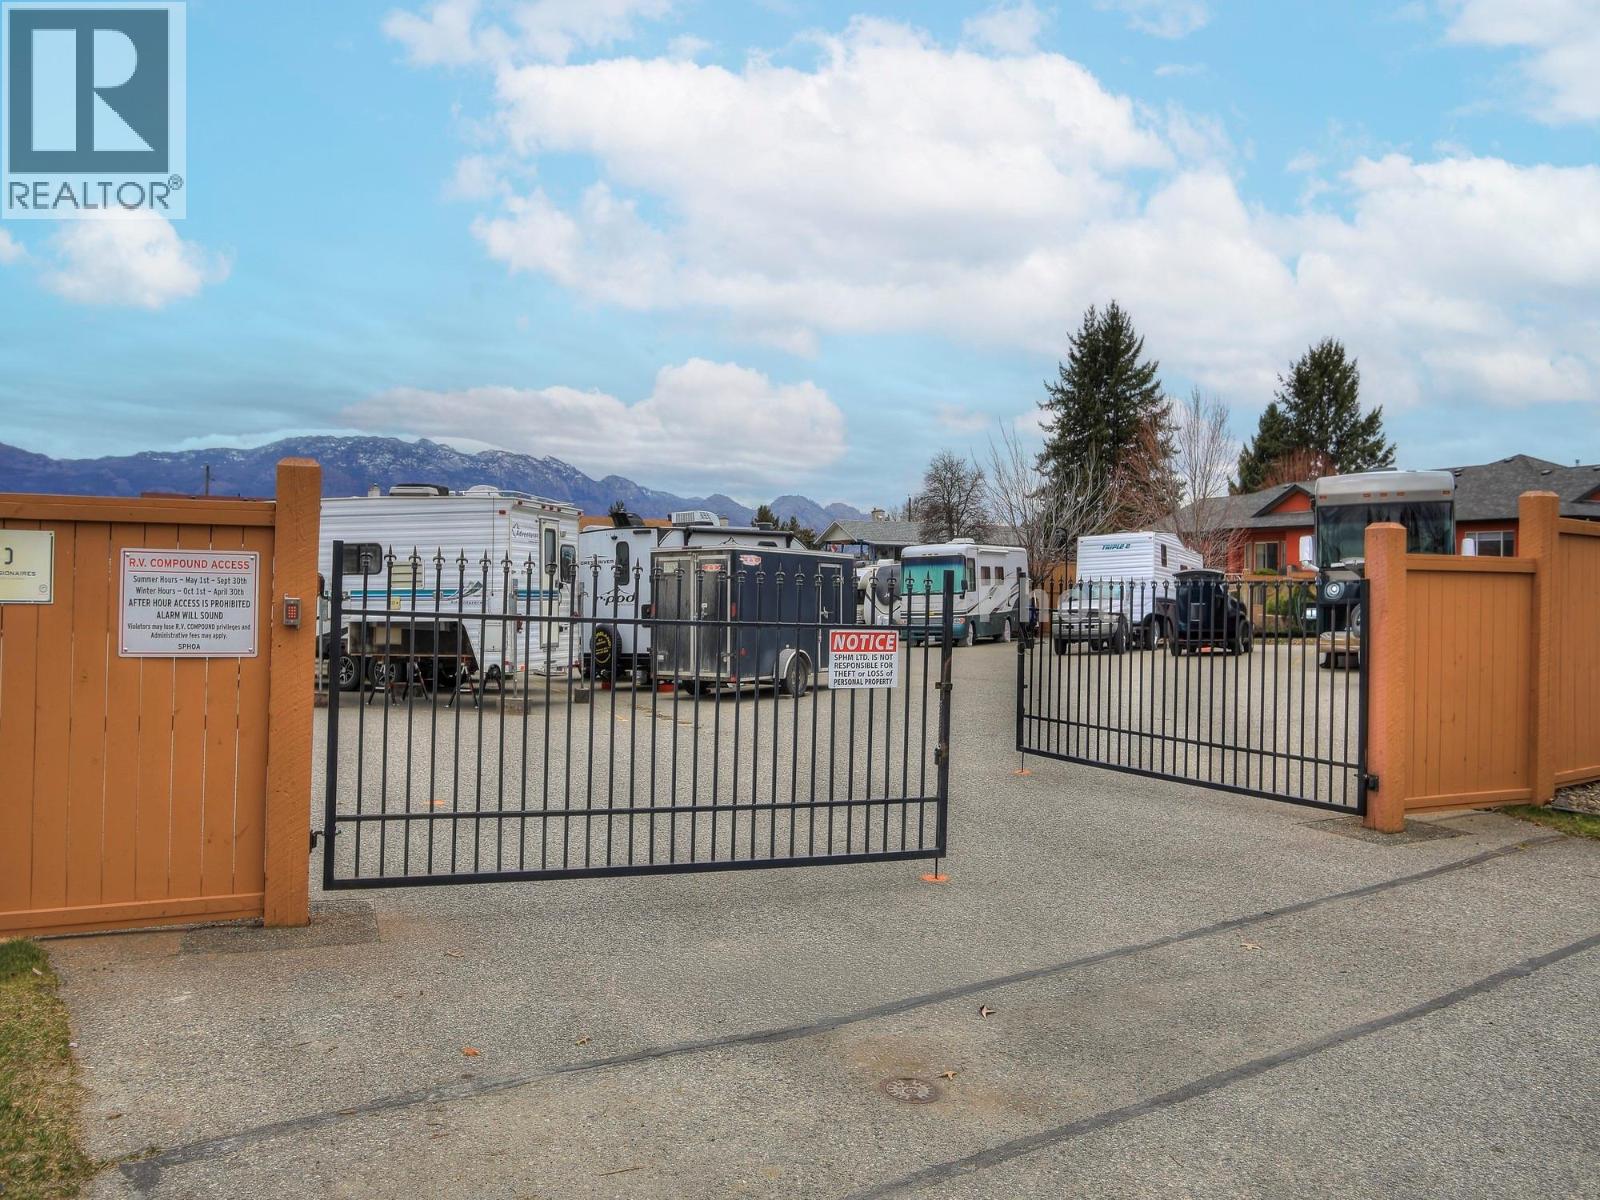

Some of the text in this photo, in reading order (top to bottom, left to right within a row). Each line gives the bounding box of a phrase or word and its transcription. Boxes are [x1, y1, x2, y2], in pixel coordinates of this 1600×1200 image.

[128, 558, 250, 570] R.V. COMPOUND ACCESS
[133, 575, 158, 583] Summer
[160, 576, 178, 584] Hours
[186, 577, 198, 586] May
[217, 577, 231, 586] Sept
[232, 577, 248, 585] 30th
[135, 586, 157, 595] Winter
[158, 587, 175, 595] Hours
[213, 588, 228, 598] April
[229, 588, 245, 596] 30th
[128, 598, 251, 609] AFTER HOUR ACCESS IS PROHIBITED
[156, 611, 224, 620] ALARM WILL SOUND
[216, 624, 240, 632] privileges
[833, 634, 896, 651] NOTICE
[834, 670, 855, 678] THEFT
[834, 678, 893, 686] PERSONAL PROPERTY
